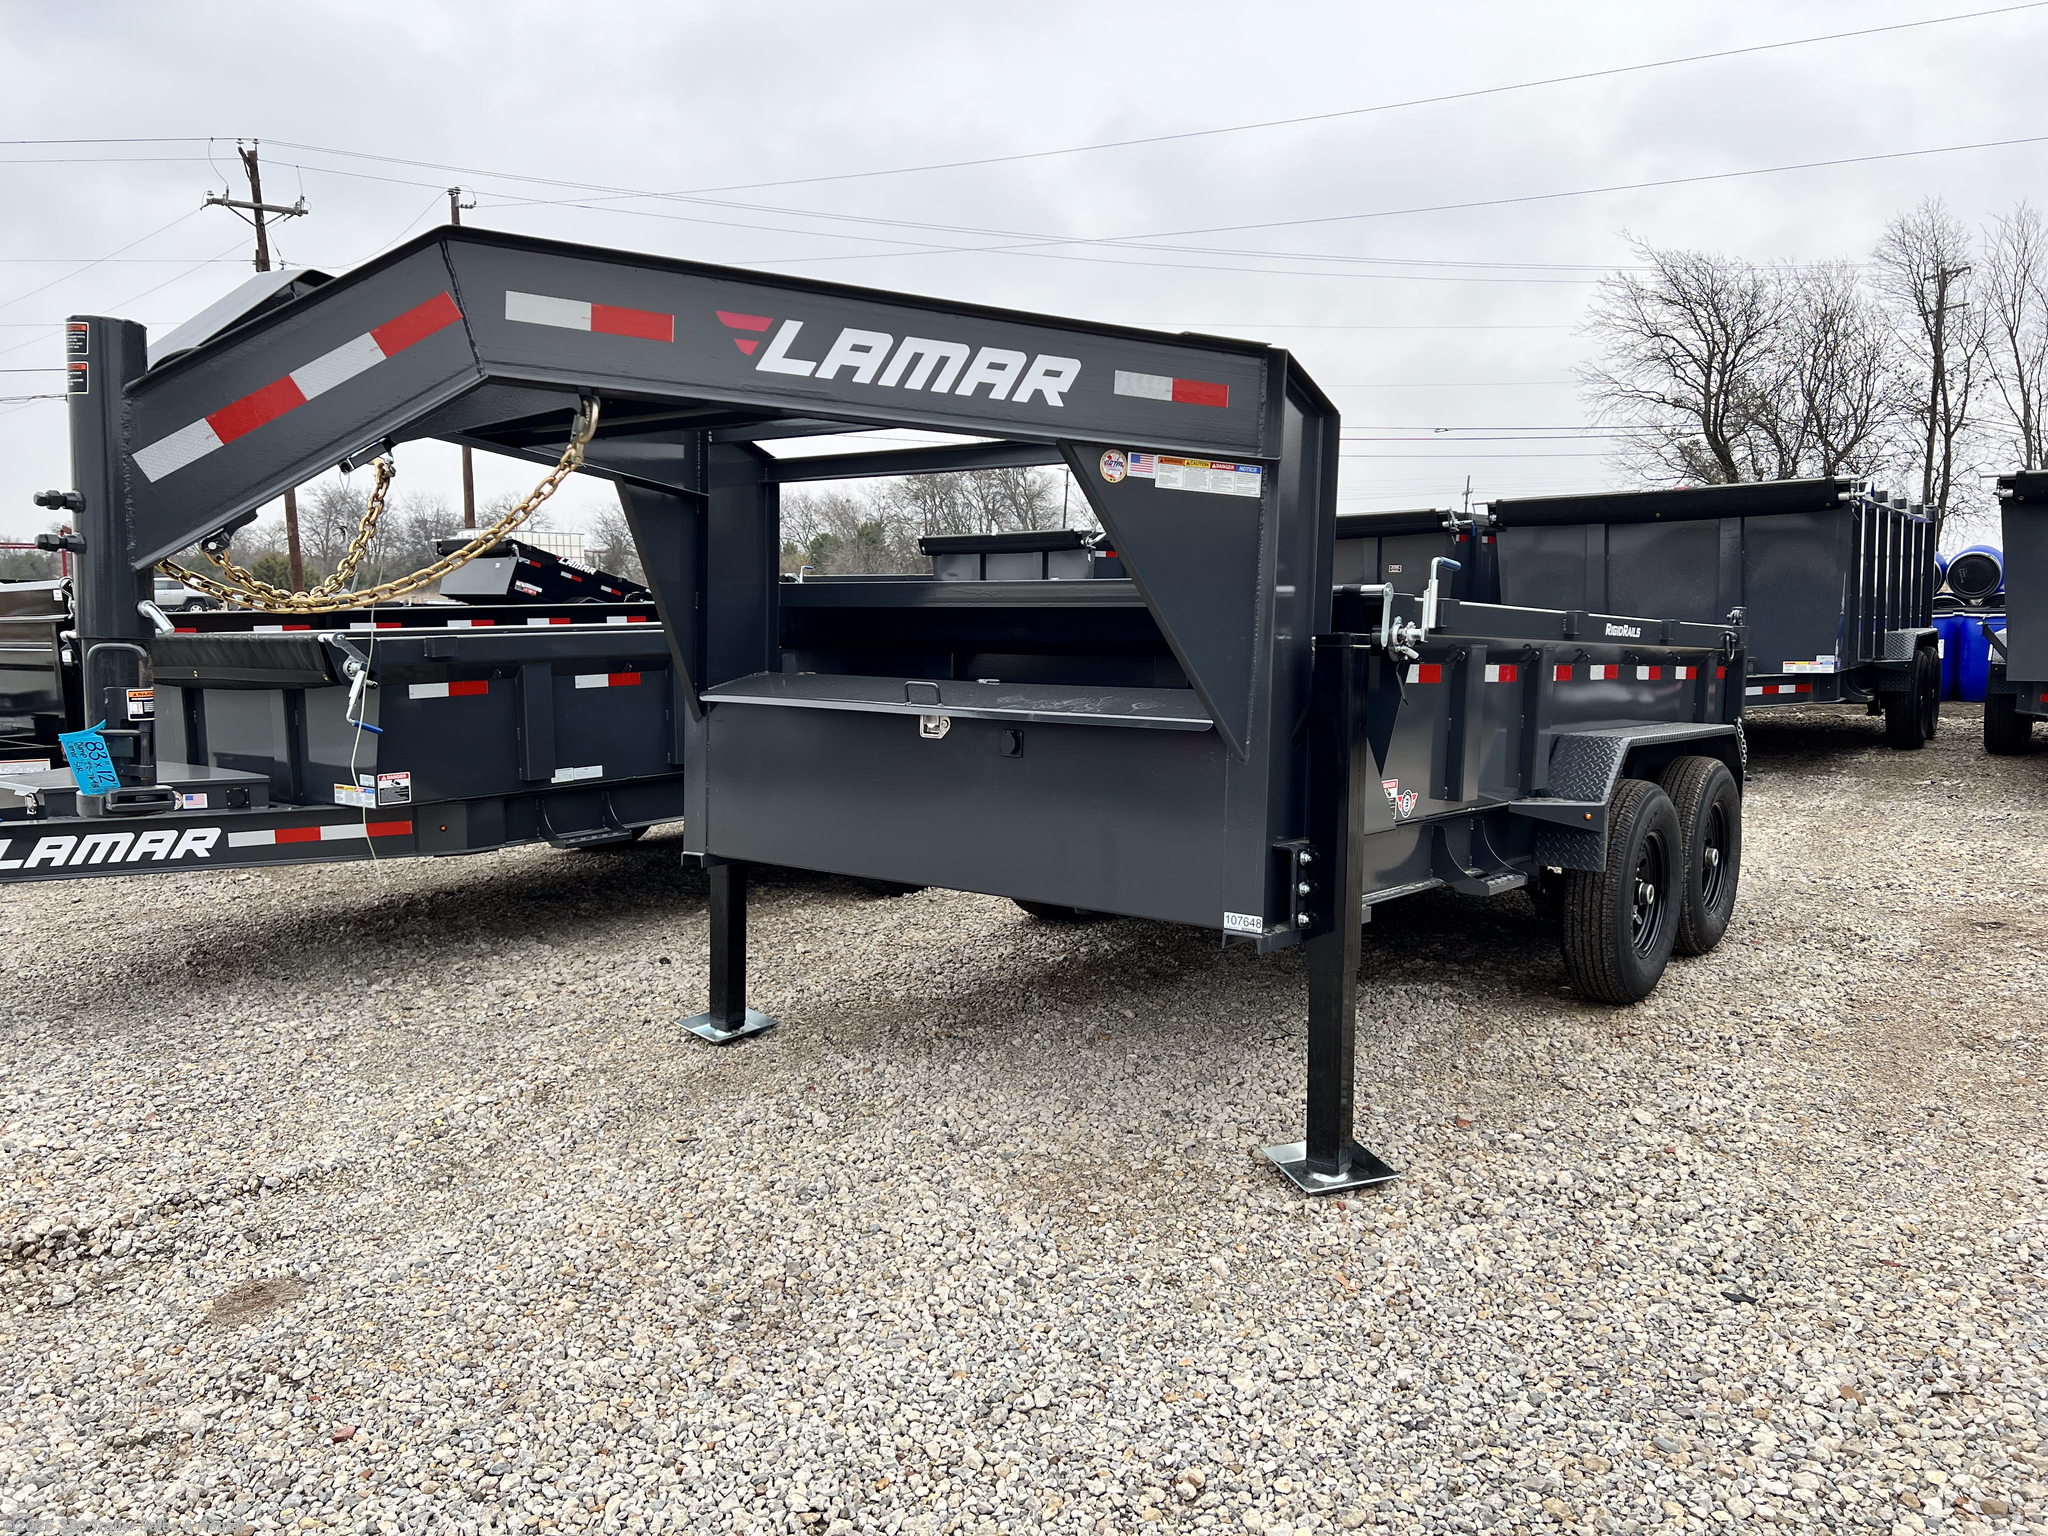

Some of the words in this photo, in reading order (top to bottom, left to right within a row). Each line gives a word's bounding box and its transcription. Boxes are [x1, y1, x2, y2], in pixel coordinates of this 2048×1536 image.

[755, 319, 1082, 407] LAMAR
[558, 557, 597, 575] LAMAR
[1225, 914, 1262, 929] 107648
